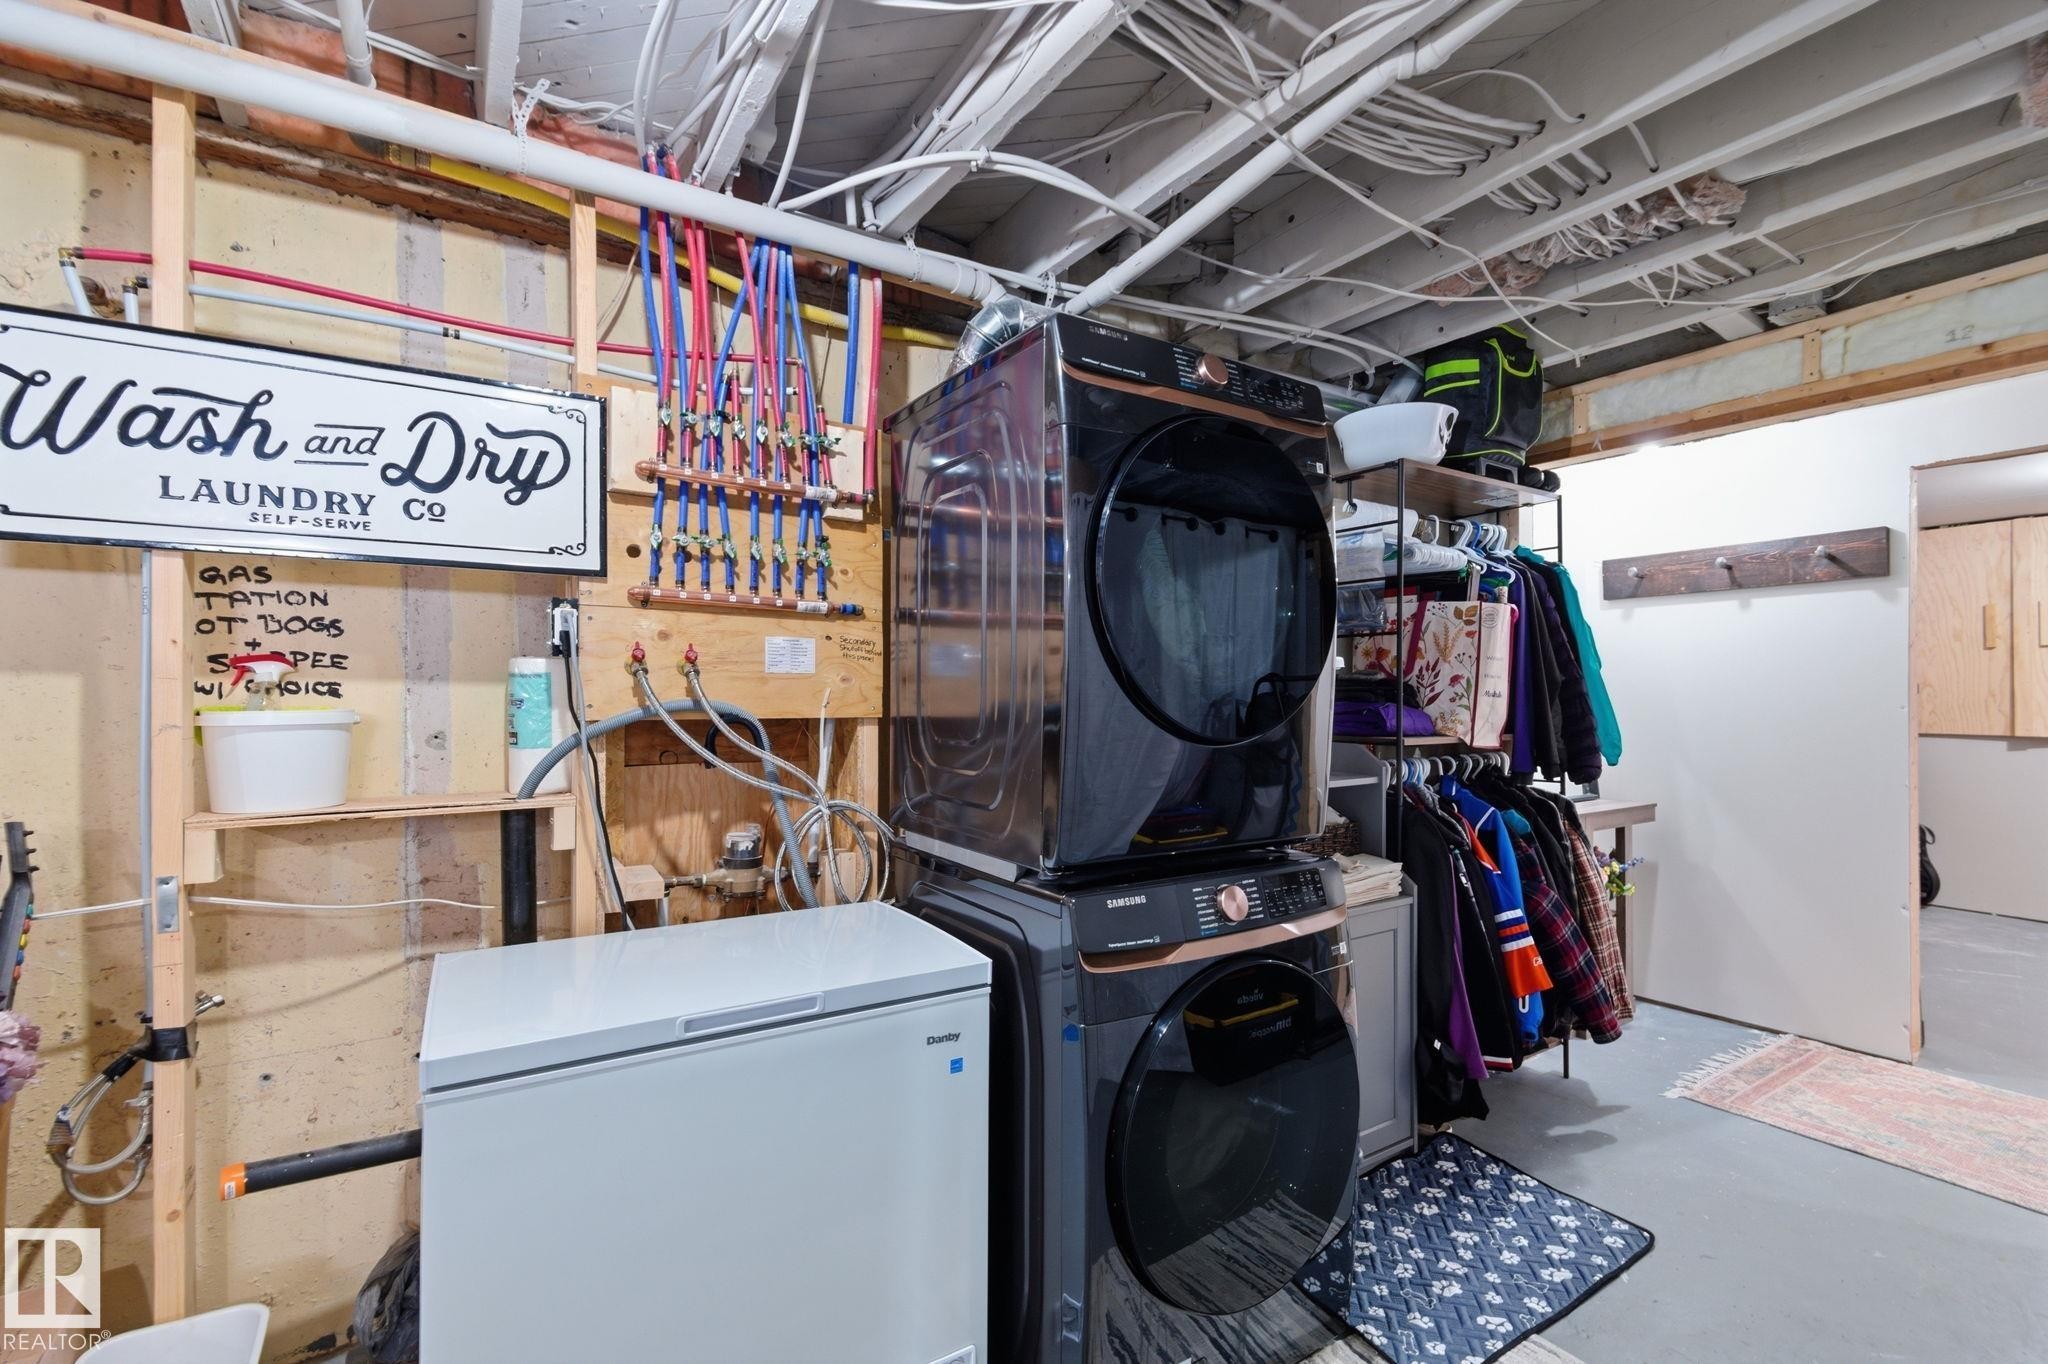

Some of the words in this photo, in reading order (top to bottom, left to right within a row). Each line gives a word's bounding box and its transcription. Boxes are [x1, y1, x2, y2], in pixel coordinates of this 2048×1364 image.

[1088, 325, 1129, 342] SAMSUNG
[0, 363, 288, 461] Wash
[304, 424, 385, 456] and
[380, 411, 571, 506] Dry
[159, 475, 376, 517] LAUNDRY
[249, 512, 372, 531] SELF-SERVE
[199, 565, 272, 585] GAS
[1106, 895, 1147, 909] SAMSUNG
[926, 1032, 961, 1046] Danby
